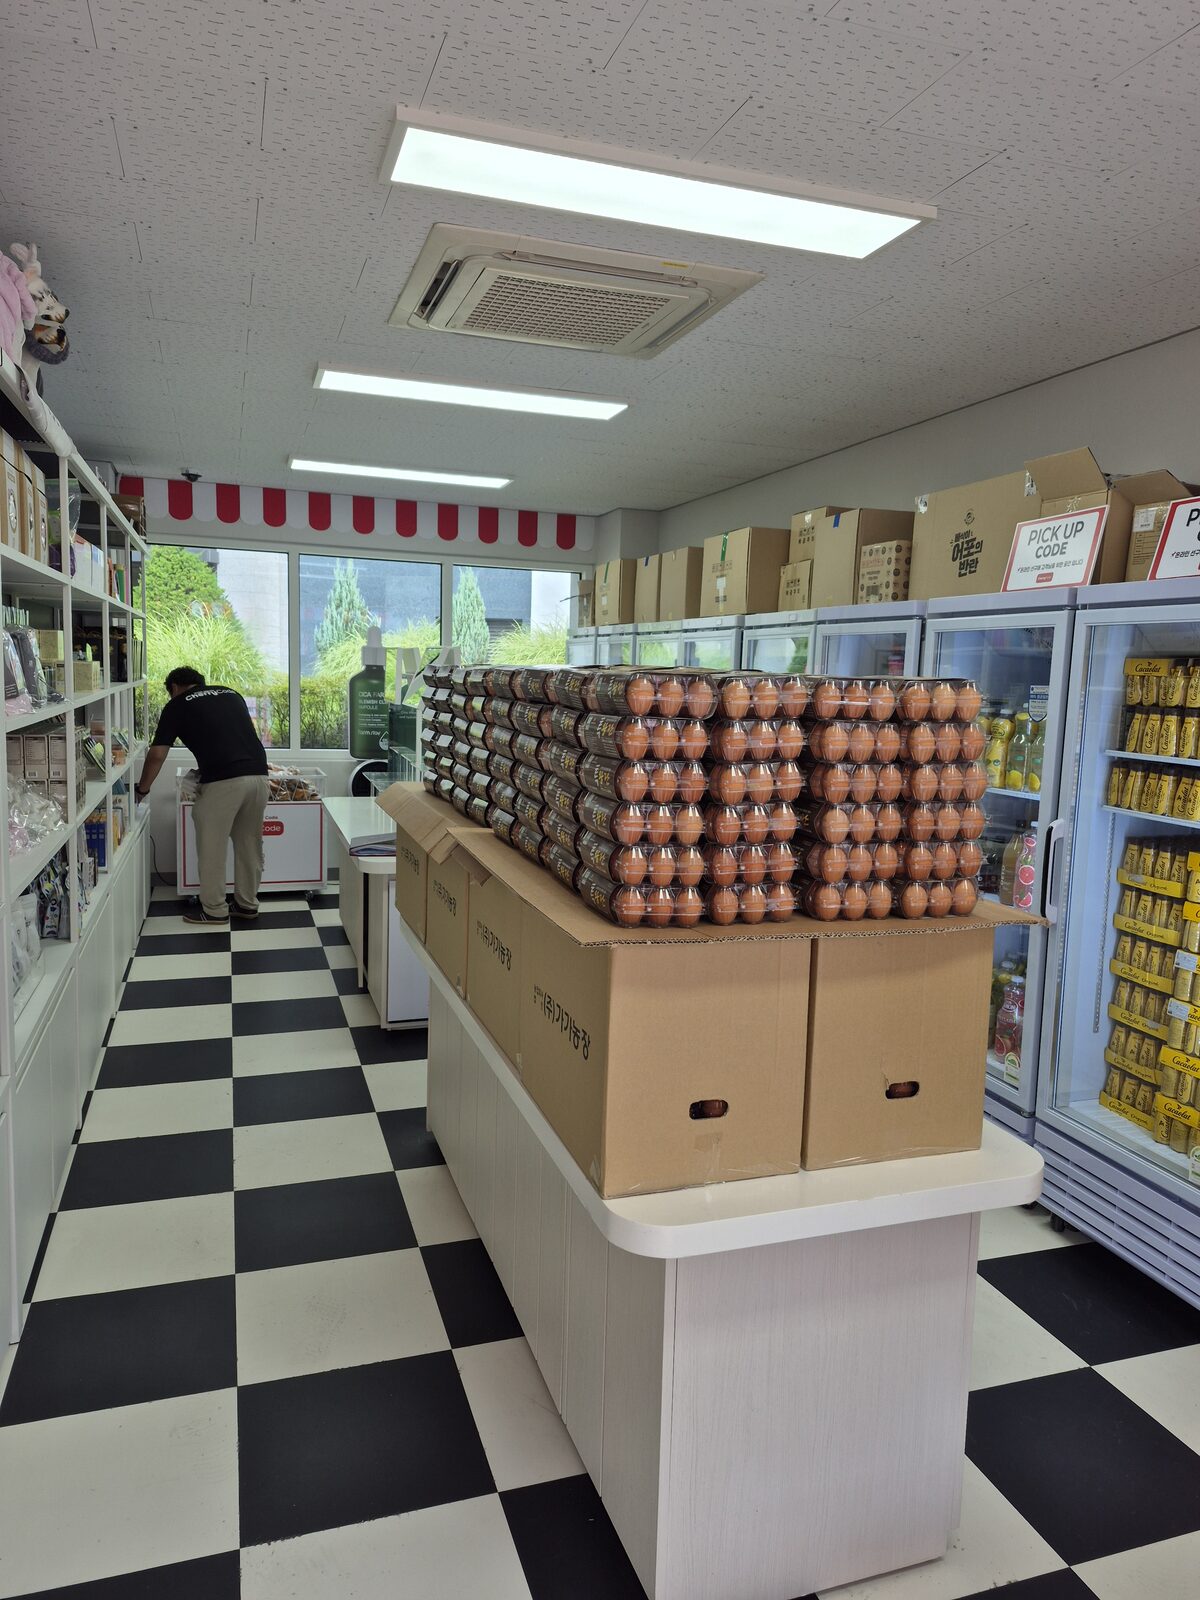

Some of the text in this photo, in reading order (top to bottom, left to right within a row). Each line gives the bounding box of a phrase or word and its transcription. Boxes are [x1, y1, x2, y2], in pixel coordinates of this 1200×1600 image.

[1028, 520, 1085, 546] PICK UP
[951, 537, 984, 562] 어포의
[1035, 541, 1069, 559] CODE
[957, 557, 979, 578] 반란
[1135, 663, 1161, 673] Cacaolat
[1146, 723, 1155, 749] Cacaolat
[1162, 724, 1171, 750] Cacaolat
[482, 924, 512, 971] (주)가가농장
[543, 992, 591, 1061] (주)가가농장
[1172, 1055, 1200, 1073] Cacaolat
[1163, 1102, 1192, 1121] Cacaolat
